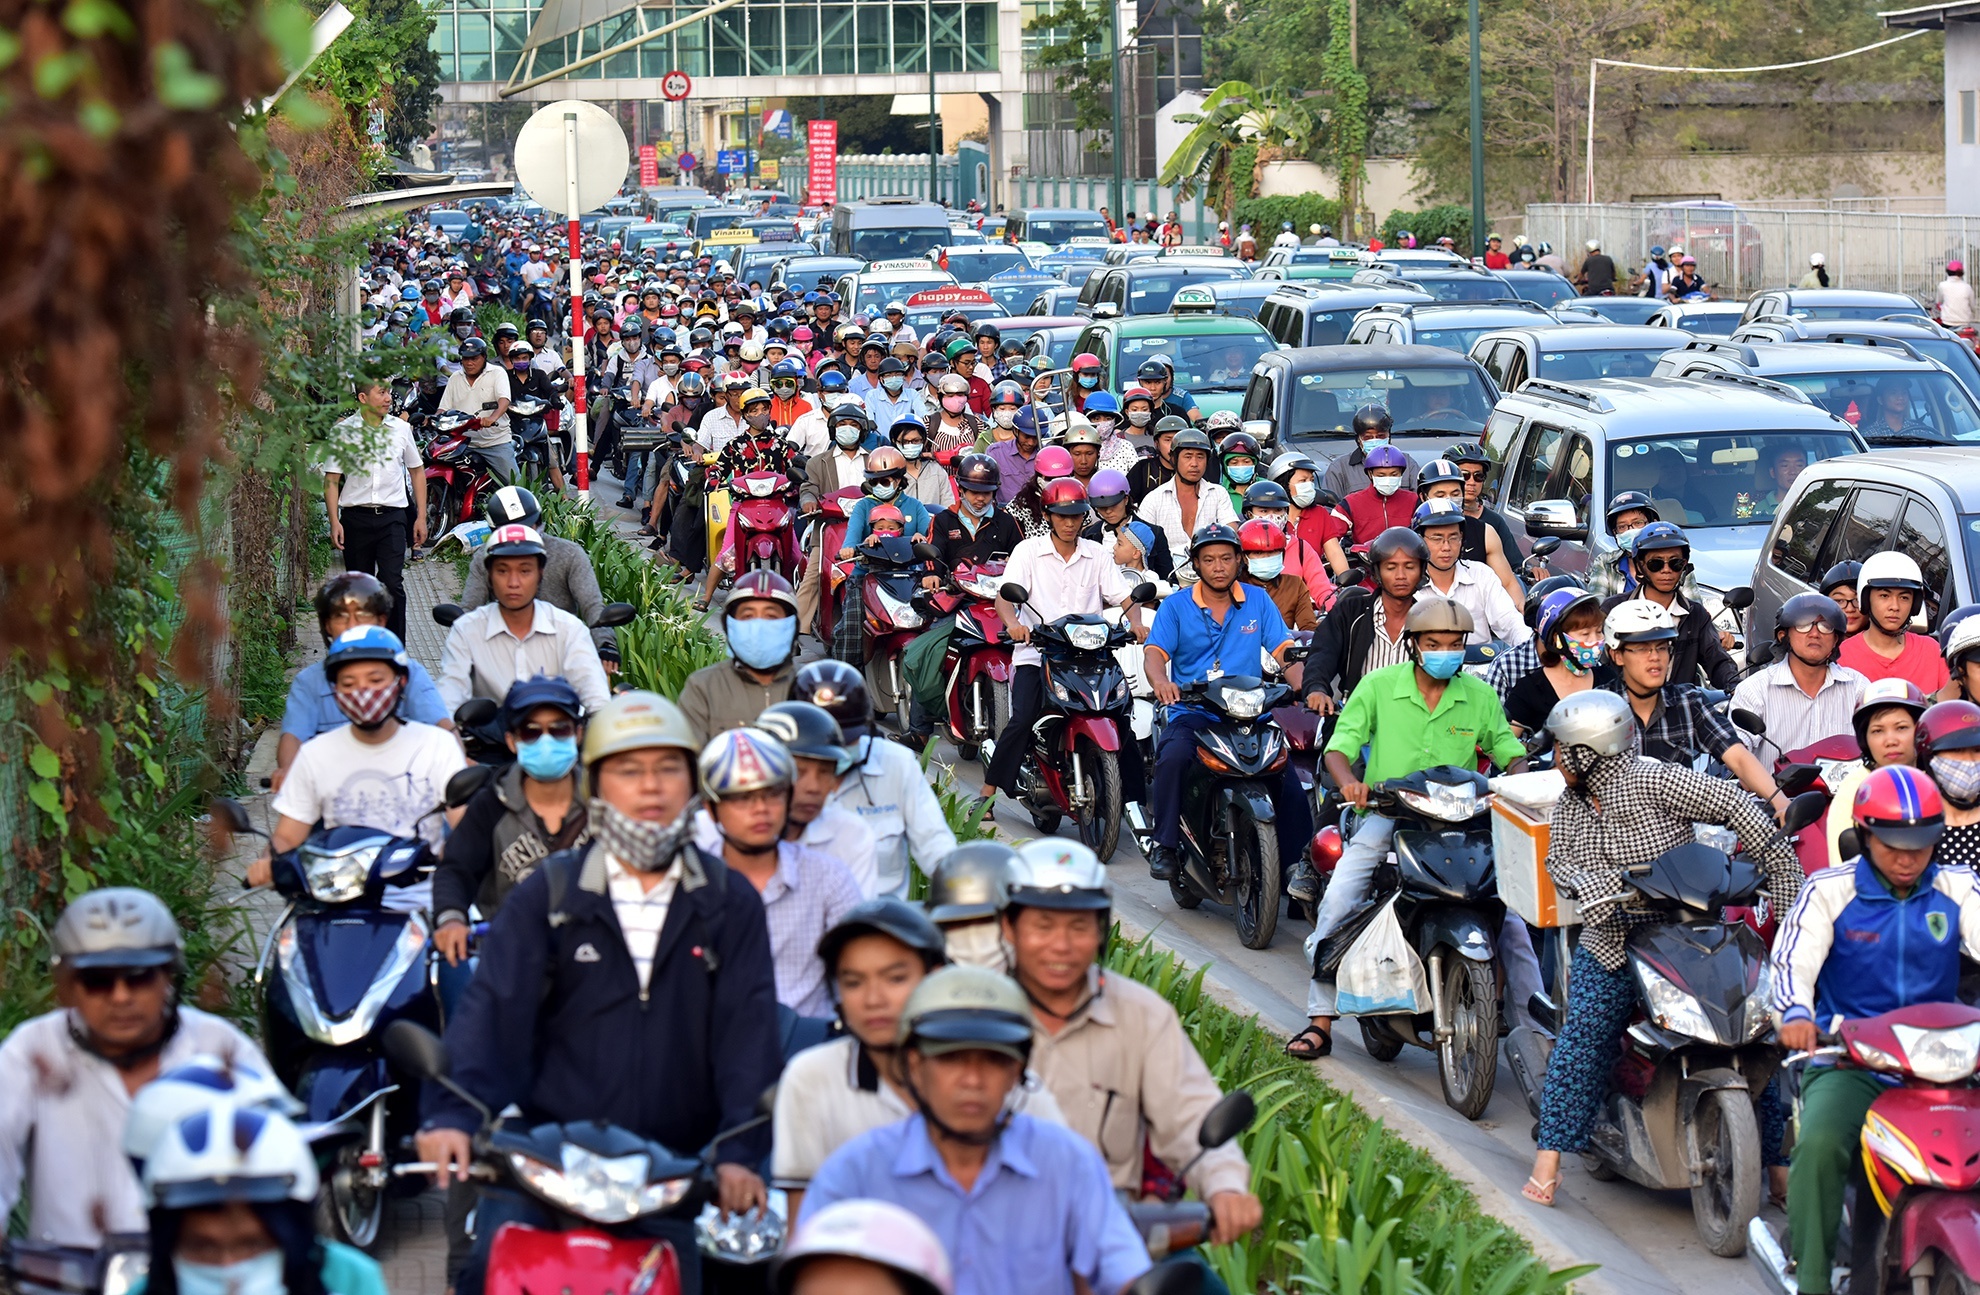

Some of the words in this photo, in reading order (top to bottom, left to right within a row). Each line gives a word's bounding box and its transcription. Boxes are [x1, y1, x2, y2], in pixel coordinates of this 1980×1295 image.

[714, 229, 749, 237] Vinataxi
[1179, 293, 1212, 302] TAXI
[1929, 1105, 1967, 1113] HONDA
